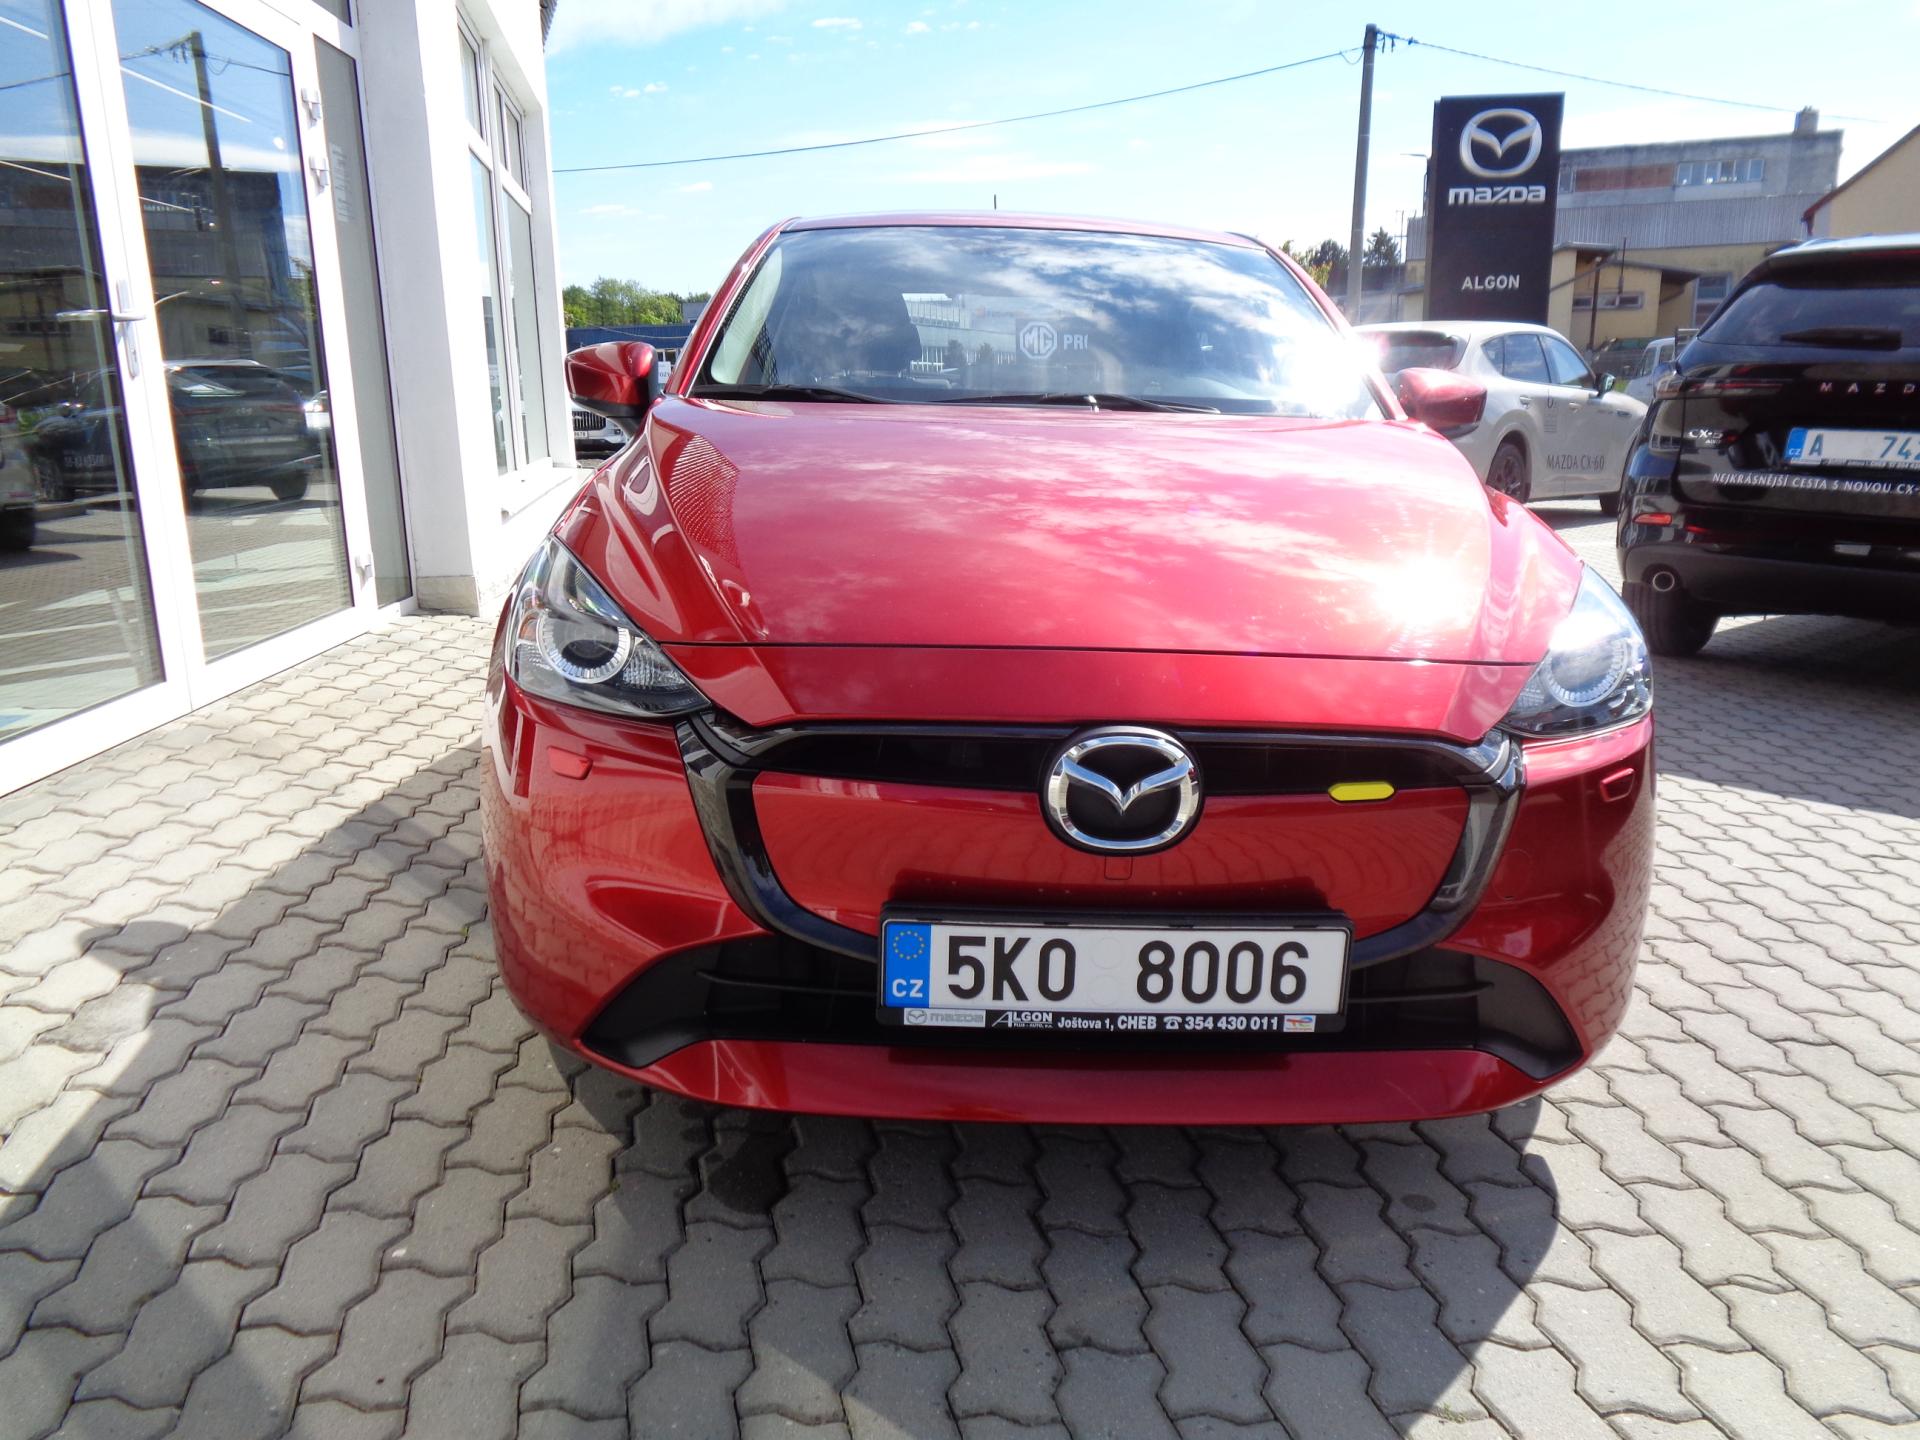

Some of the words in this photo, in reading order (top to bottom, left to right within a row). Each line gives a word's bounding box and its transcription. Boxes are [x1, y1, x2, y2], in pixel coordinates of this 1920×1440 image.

[1447, 185, 1546, 206] mazda
[1461, 274, 1520, 290] ALGON
[1788, 448, 1802, 456] CZ
[1808, 433, 1824, 456] A
[1712, 472, 1789, 488] NEJKRÁSNĚJŠÍ
[1792, 478, 1828, 489] CESTA
[1831, 480, 1839, 490] S
[1843, 480, 1892, 493] NOVOU
[947, 936, 1077, 1002] 5K0
[1136, 939, 1310, 1004] 8006
[891, 978, 924, 998] CZ
[991, 1011, 1053, 1028] ALGON
[1057, 1014, 1102, 1029] Joštova
[1104, 1018, 1114, 1031] 1,
[1117, 1015, 1157, 1030] CHEB
[1184, 1016, 1214, 1030] 354
[1217, 1016, 1247, 1030] 430
[1250, 1016, 1278, 1030] 011
